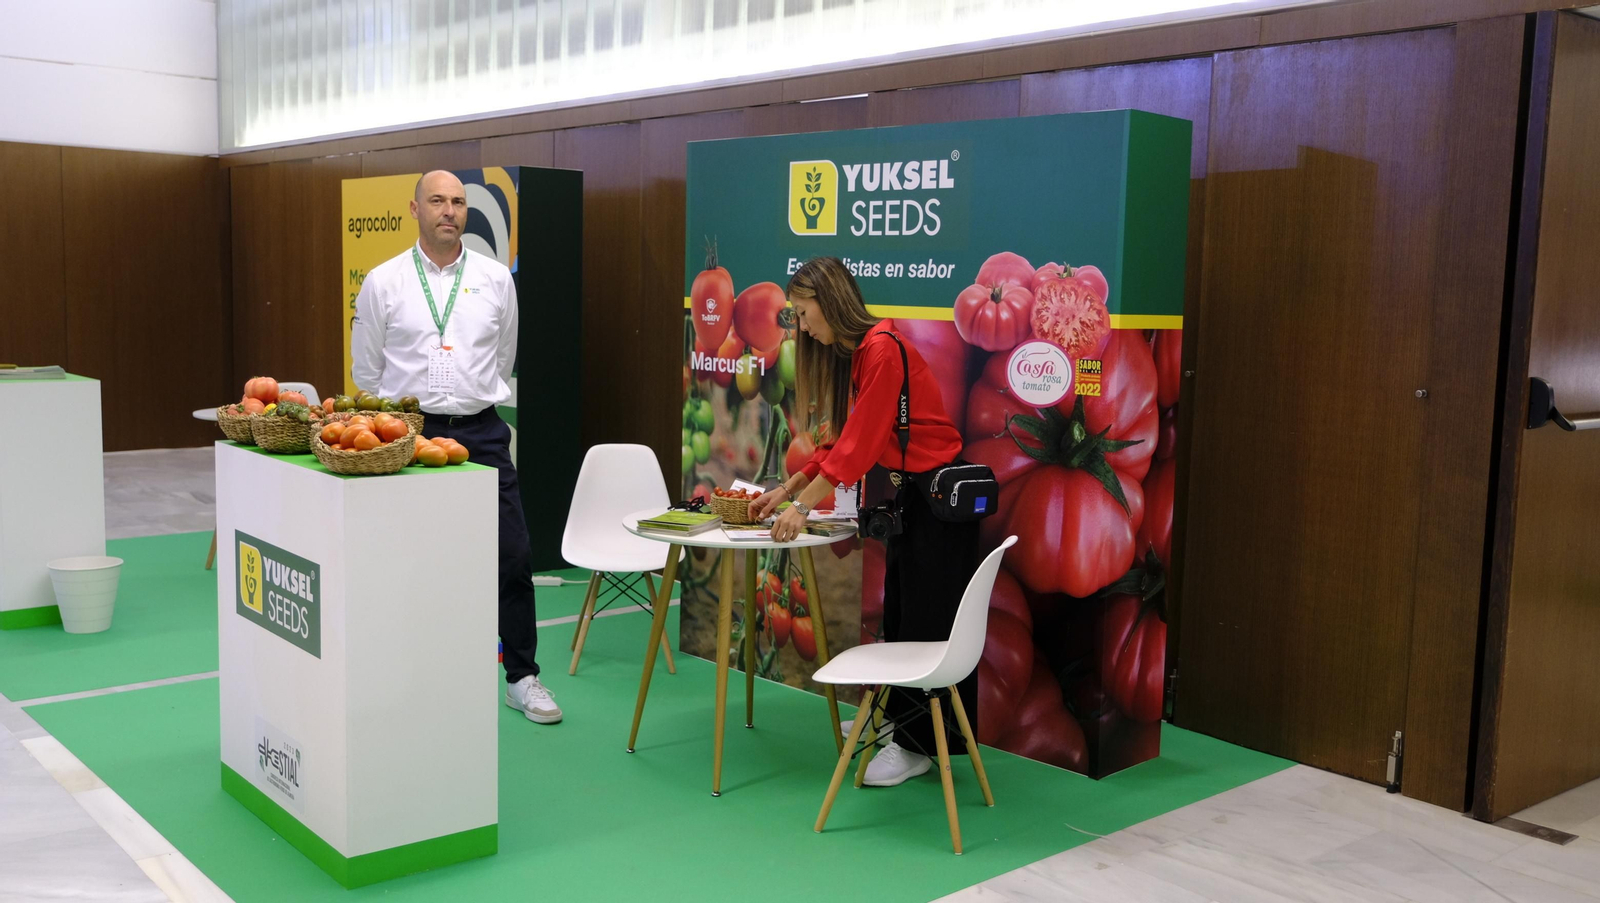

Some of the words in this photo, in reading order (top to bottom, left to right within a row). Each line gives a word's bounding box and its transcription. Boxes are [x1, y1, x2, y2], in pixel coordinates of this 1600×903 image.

[348, 210, 402, 239] agrocolor
[850, 198, 941, 237] SEEDS
[349, 268, 368, 286] Má
[884, 262, 904, 278] en
[907, 258, 956, 279] sabor
[691, 351, 744, 375] Marcus
[748, 355, 765, 377] F1
[1079, 359, 1101, 370] SABOR
[1022, 381, 1051, 392] tomato
[1042, 374, 1062, 384] rosa
[1074, 383, 1101, 396] 2022
[900, 394, 908, 424] SONY
[268, 590, 309, 639] SEEDS
